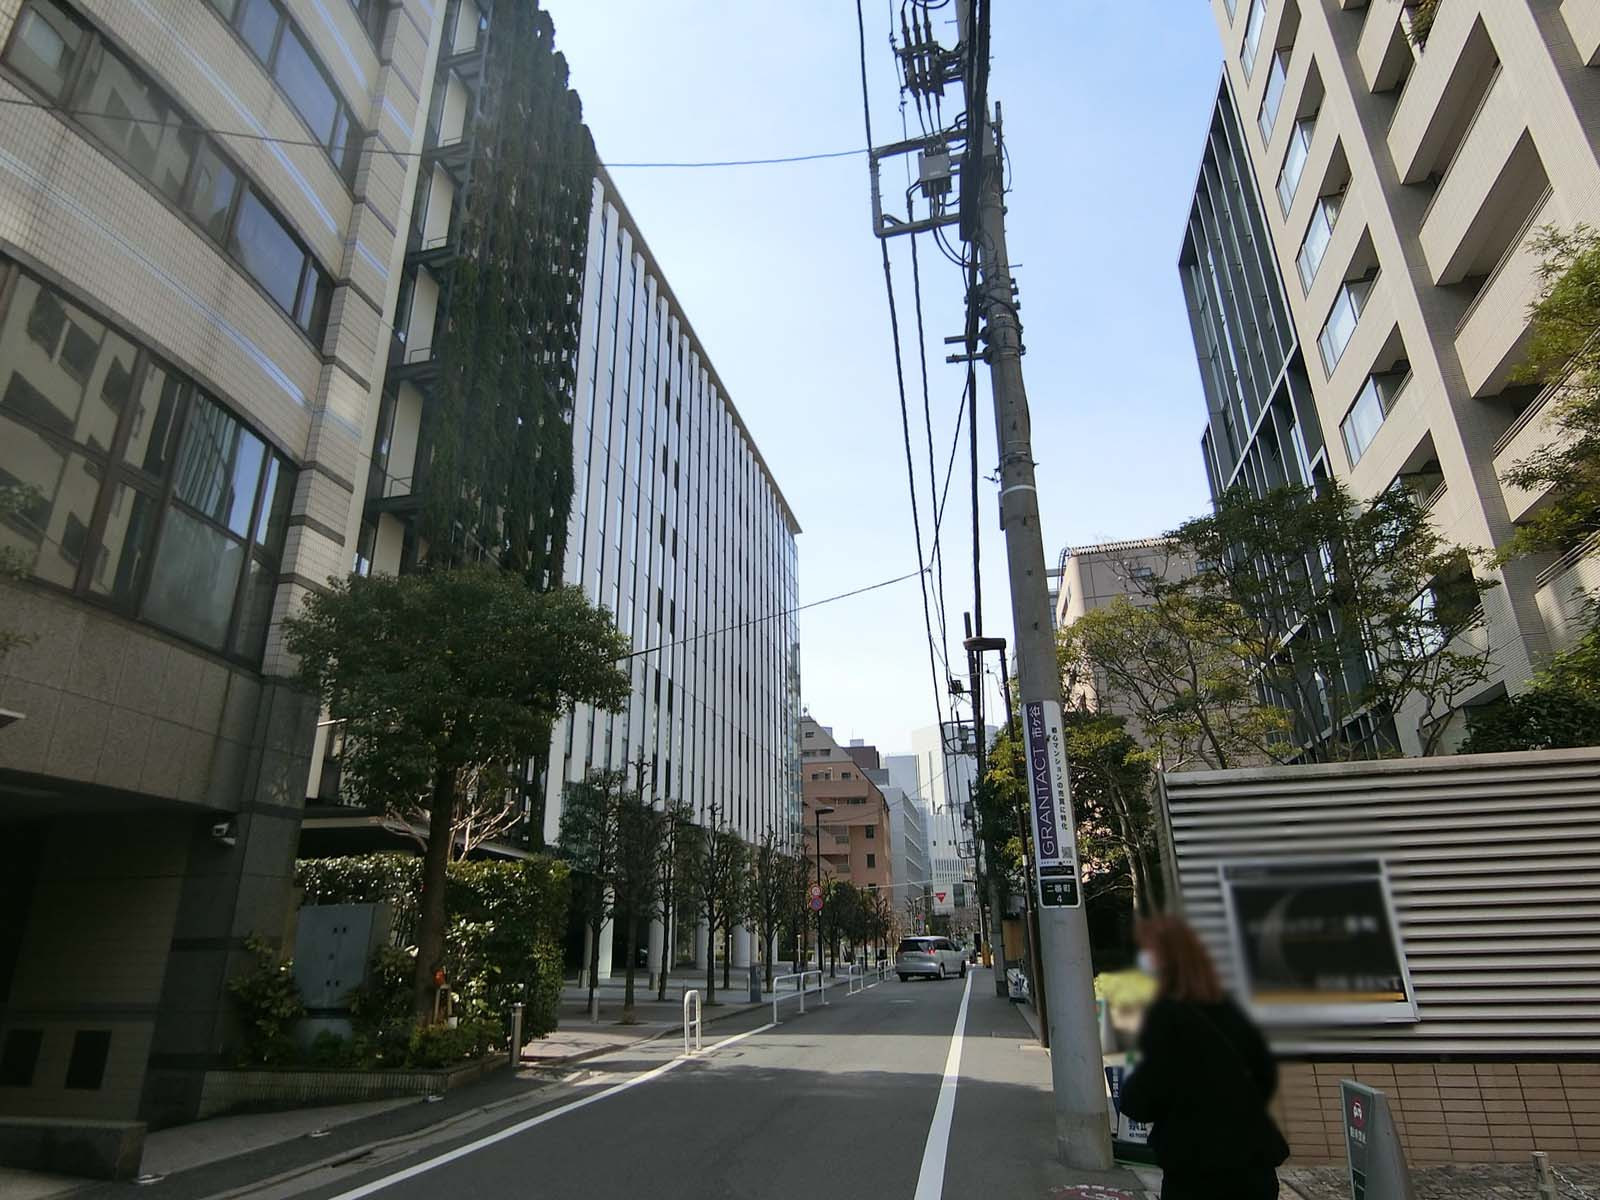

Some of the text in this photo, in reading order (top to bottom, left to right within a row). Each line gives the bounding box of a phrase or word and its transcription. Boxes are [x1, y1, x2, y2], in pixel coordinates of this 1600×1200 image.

[1033, 747, 1055, 856] GRANTACT
[1047, 884, 1071, 893] 二番町
[1056, 894, 1063, 903] 4
